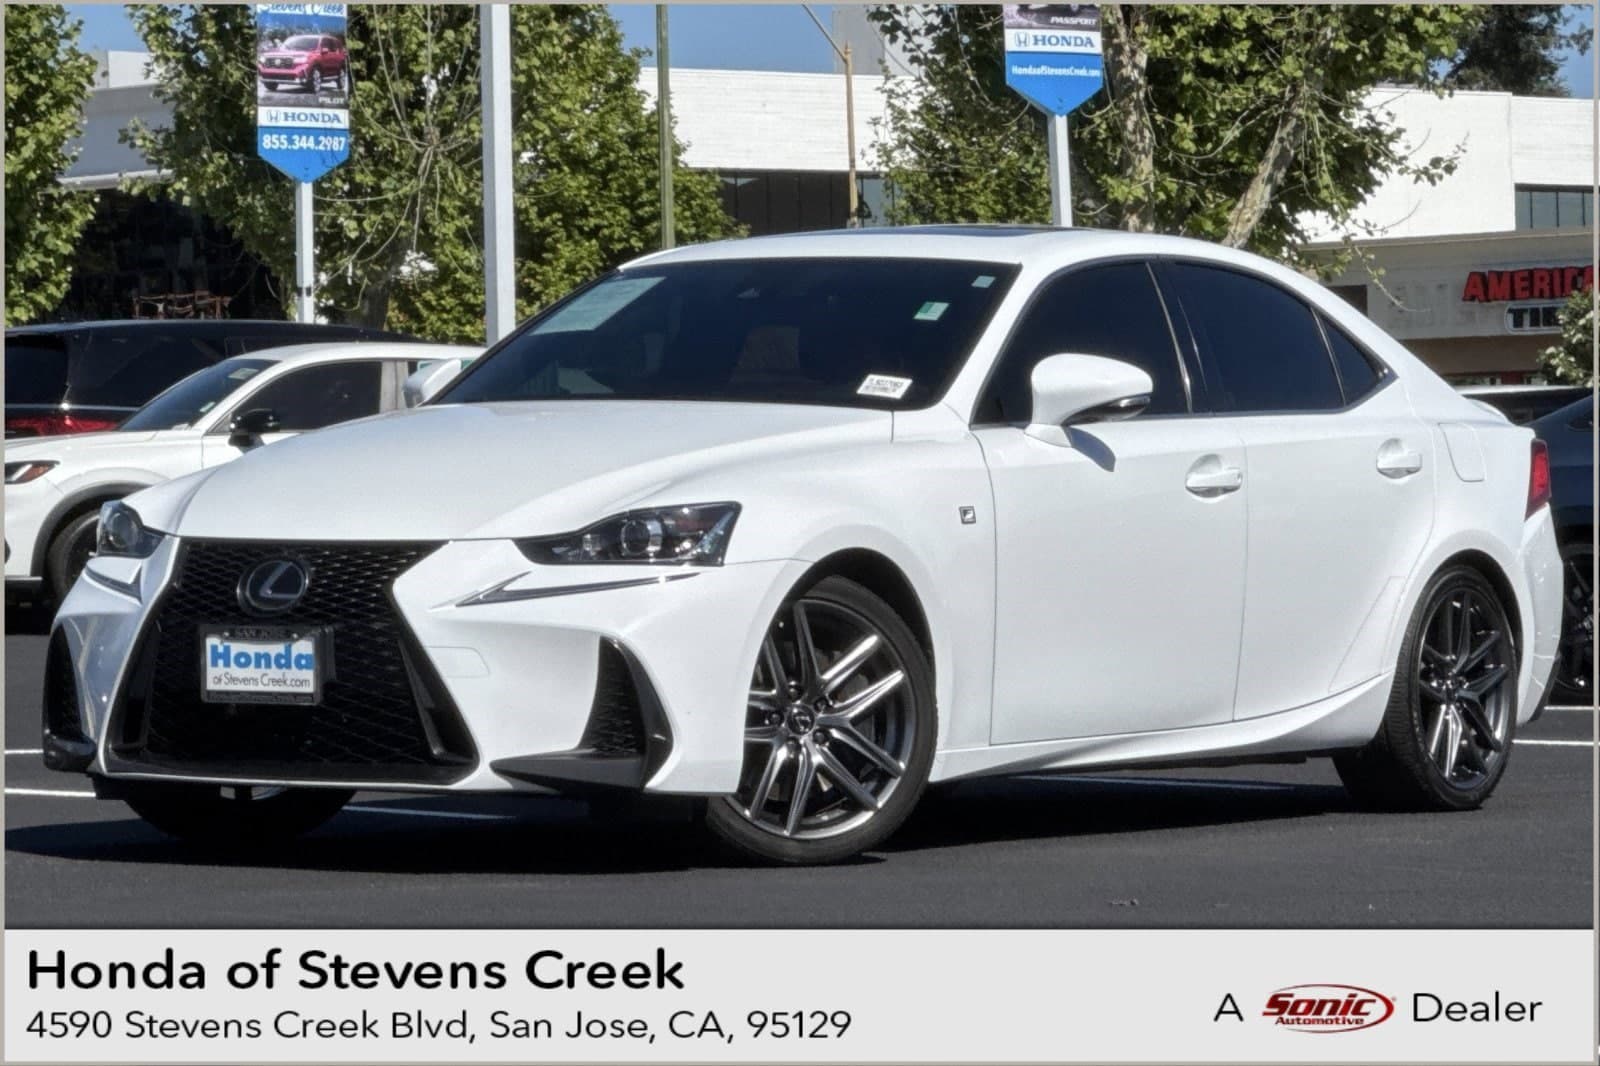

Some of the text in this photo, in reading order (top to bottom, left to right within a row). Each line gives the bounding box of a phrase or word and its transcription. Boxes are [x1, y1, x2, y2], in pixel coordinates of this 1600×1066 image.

[1050, 16, 1097, 25] PASSPORT
[1032, 34, 1095, 48] HONDA
[283, 111, 342, 124] HONDA
[262, 133, 346, 150] 855.344.2987
[210, 642, 314, 671] Honda
[212, 674, 223, 686] of
